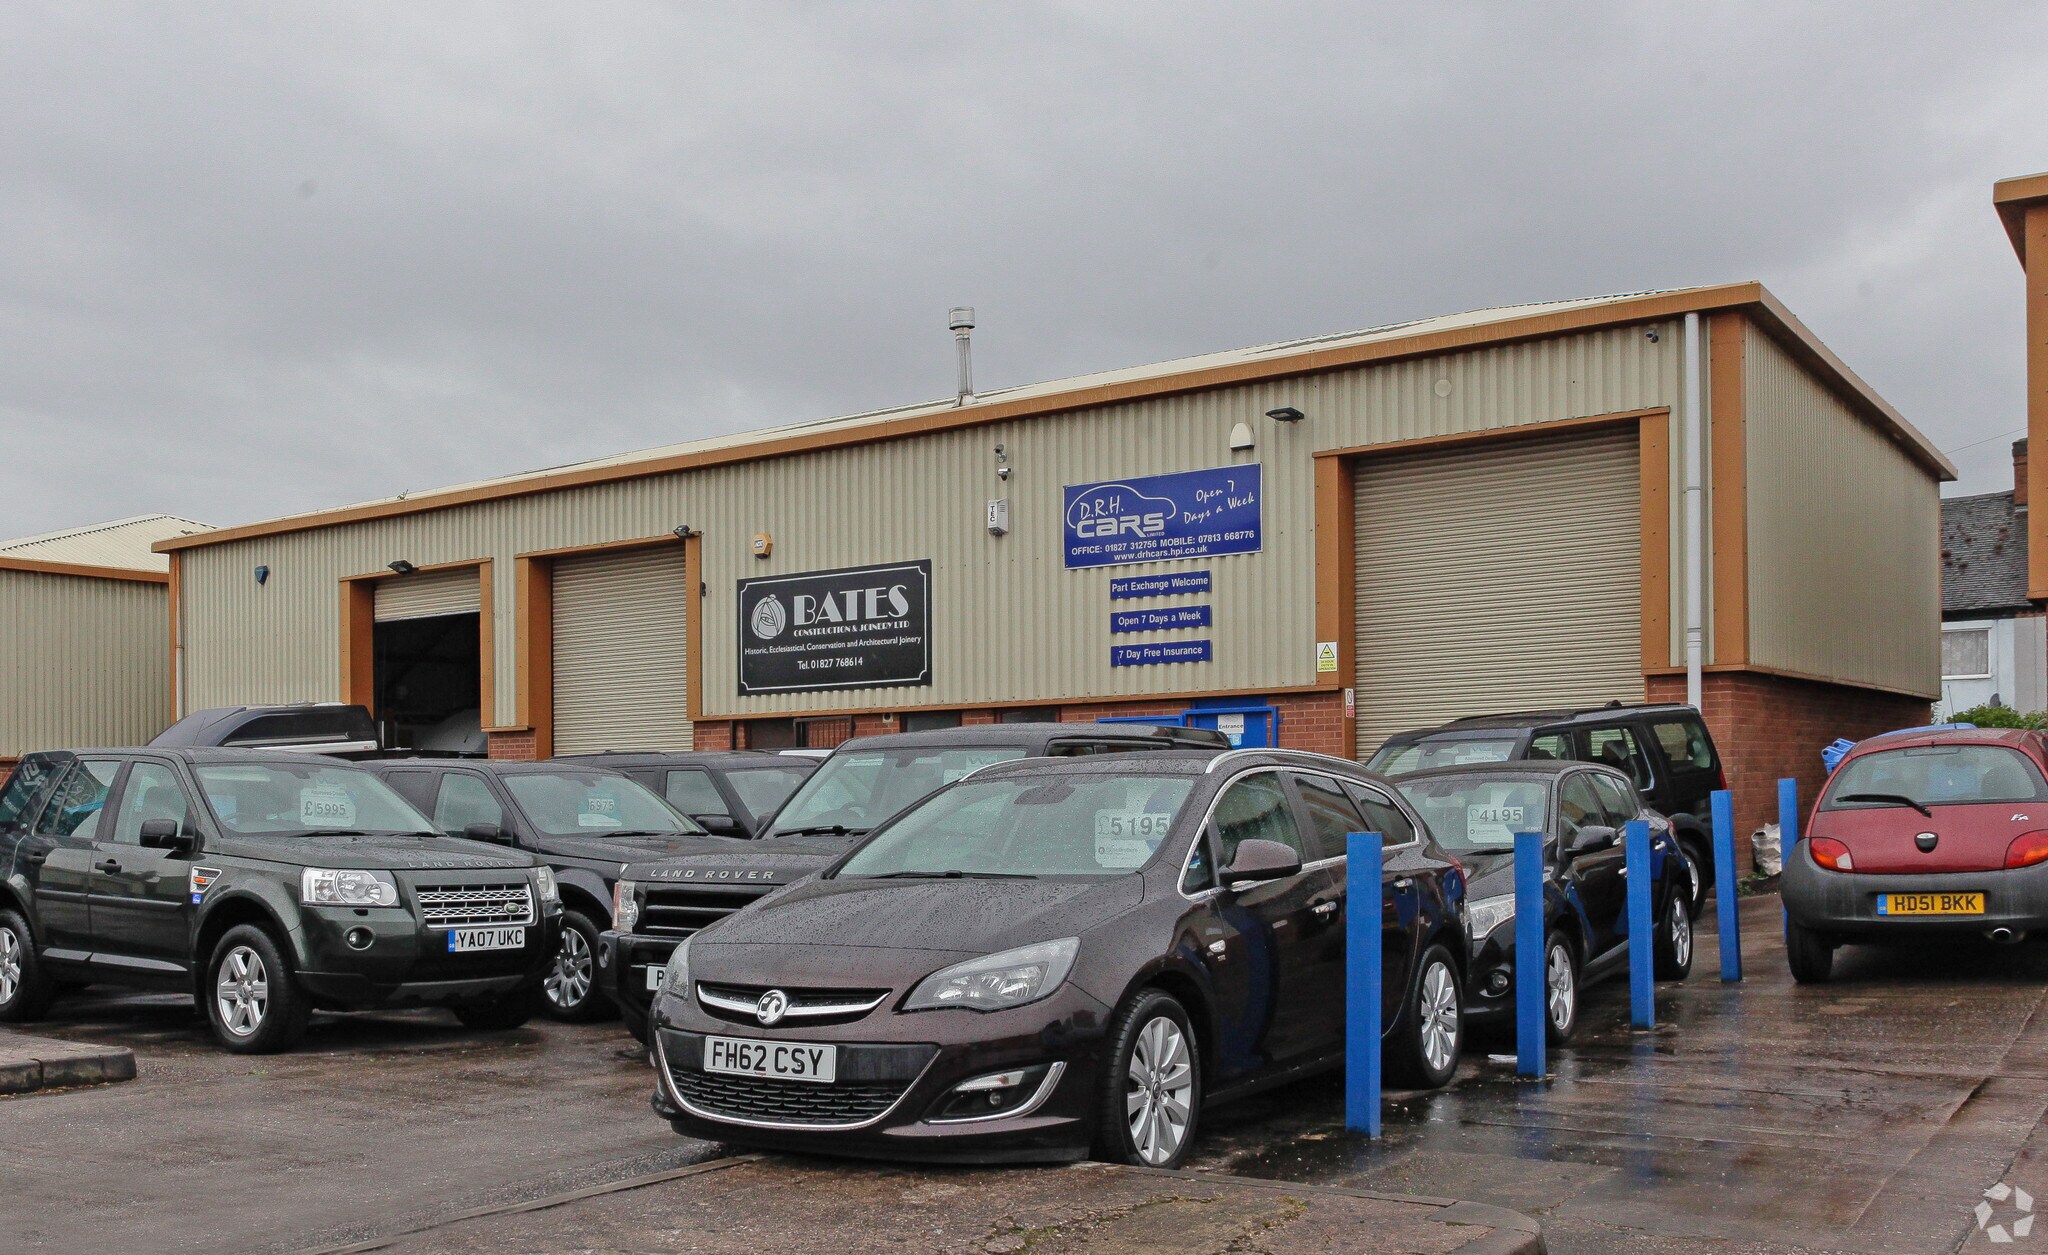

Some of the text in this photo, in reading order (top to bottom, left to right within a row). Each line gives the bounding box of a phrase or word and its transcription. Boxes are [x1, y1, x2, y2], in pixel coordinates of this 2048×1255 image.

[1196, 480, 1235, 504] Open 7
[1184, 492, 1255, 524] Days a Week
[1071, 530, 1255, 556] OFFICE: 01827 312756 MOBILE: 07813 668776
[1114, 545, 1208, 561] www.drhcars.hpi.co.uk
[1111, 576, 1209, 593] Part Exchange Welcome
[793, 584, 909, 626] BATES
[1118, 611, 1201, 627] Open 7 Days a Week
[793, 625, 851, 638] CONSTRUCTION
[859, 622, 893, 632] JOINERY
[894, 621, 910, 629] LTD
[745, 646, 768, 655] Historic,
[807, 641, 846, 651] Conservation
[859, 637, 898, 647] Architectural
[899, 636, 921, 645] Joinery
[1119, 646, 1203, 660] 7 Day Free Insurance
[797, 657, 863, 670] Tel. 01827 768614
[650, 869, 774, 879] LAND ROVER
[1894, 895, 1977, 911] HD51 BKK
[459, 930, 523, 948] YA07 UKC
[712, 1041, 824, 1076] FH62 CSY
